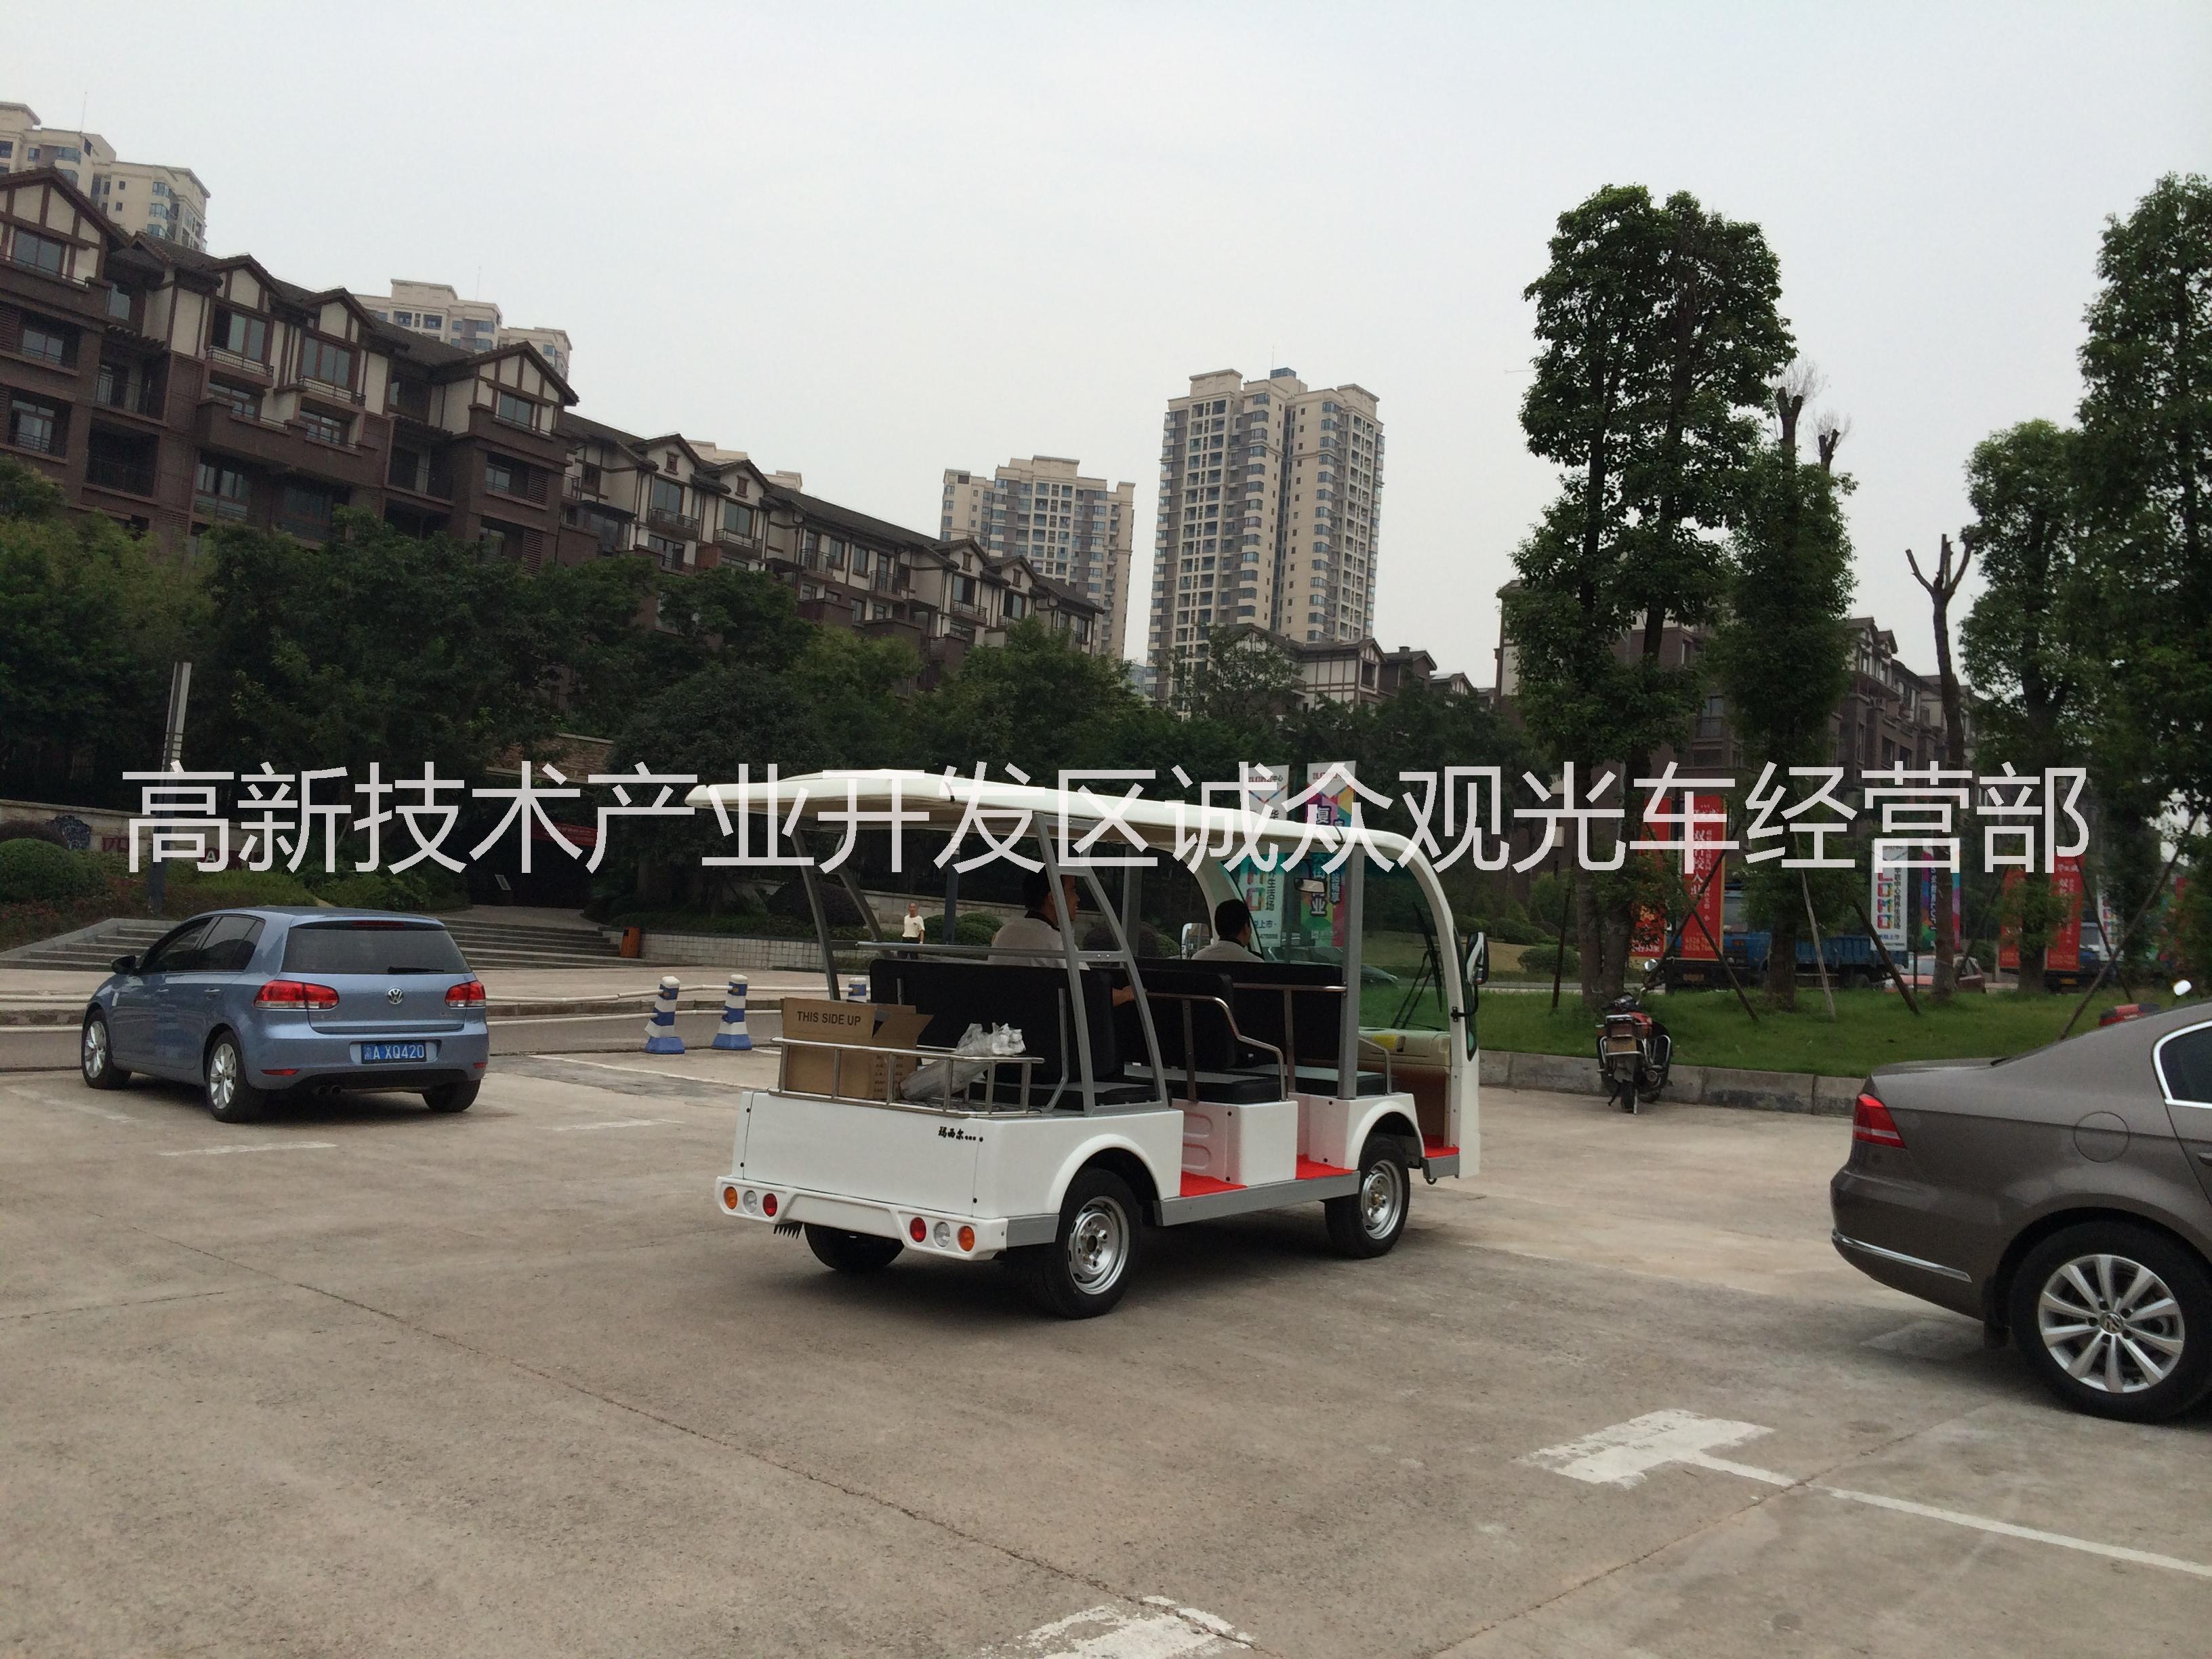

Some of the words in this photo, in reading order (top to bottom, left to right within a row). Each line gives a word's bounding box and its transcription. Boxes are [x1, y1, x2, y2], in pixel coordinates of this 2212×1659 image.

[797, 1011, 819, 1023] THIS
[822, 1013, 845, 1025] SIDE
[847, 1015, 861, 1026] UP
[385, 1044, 425, 1059] XQ420
